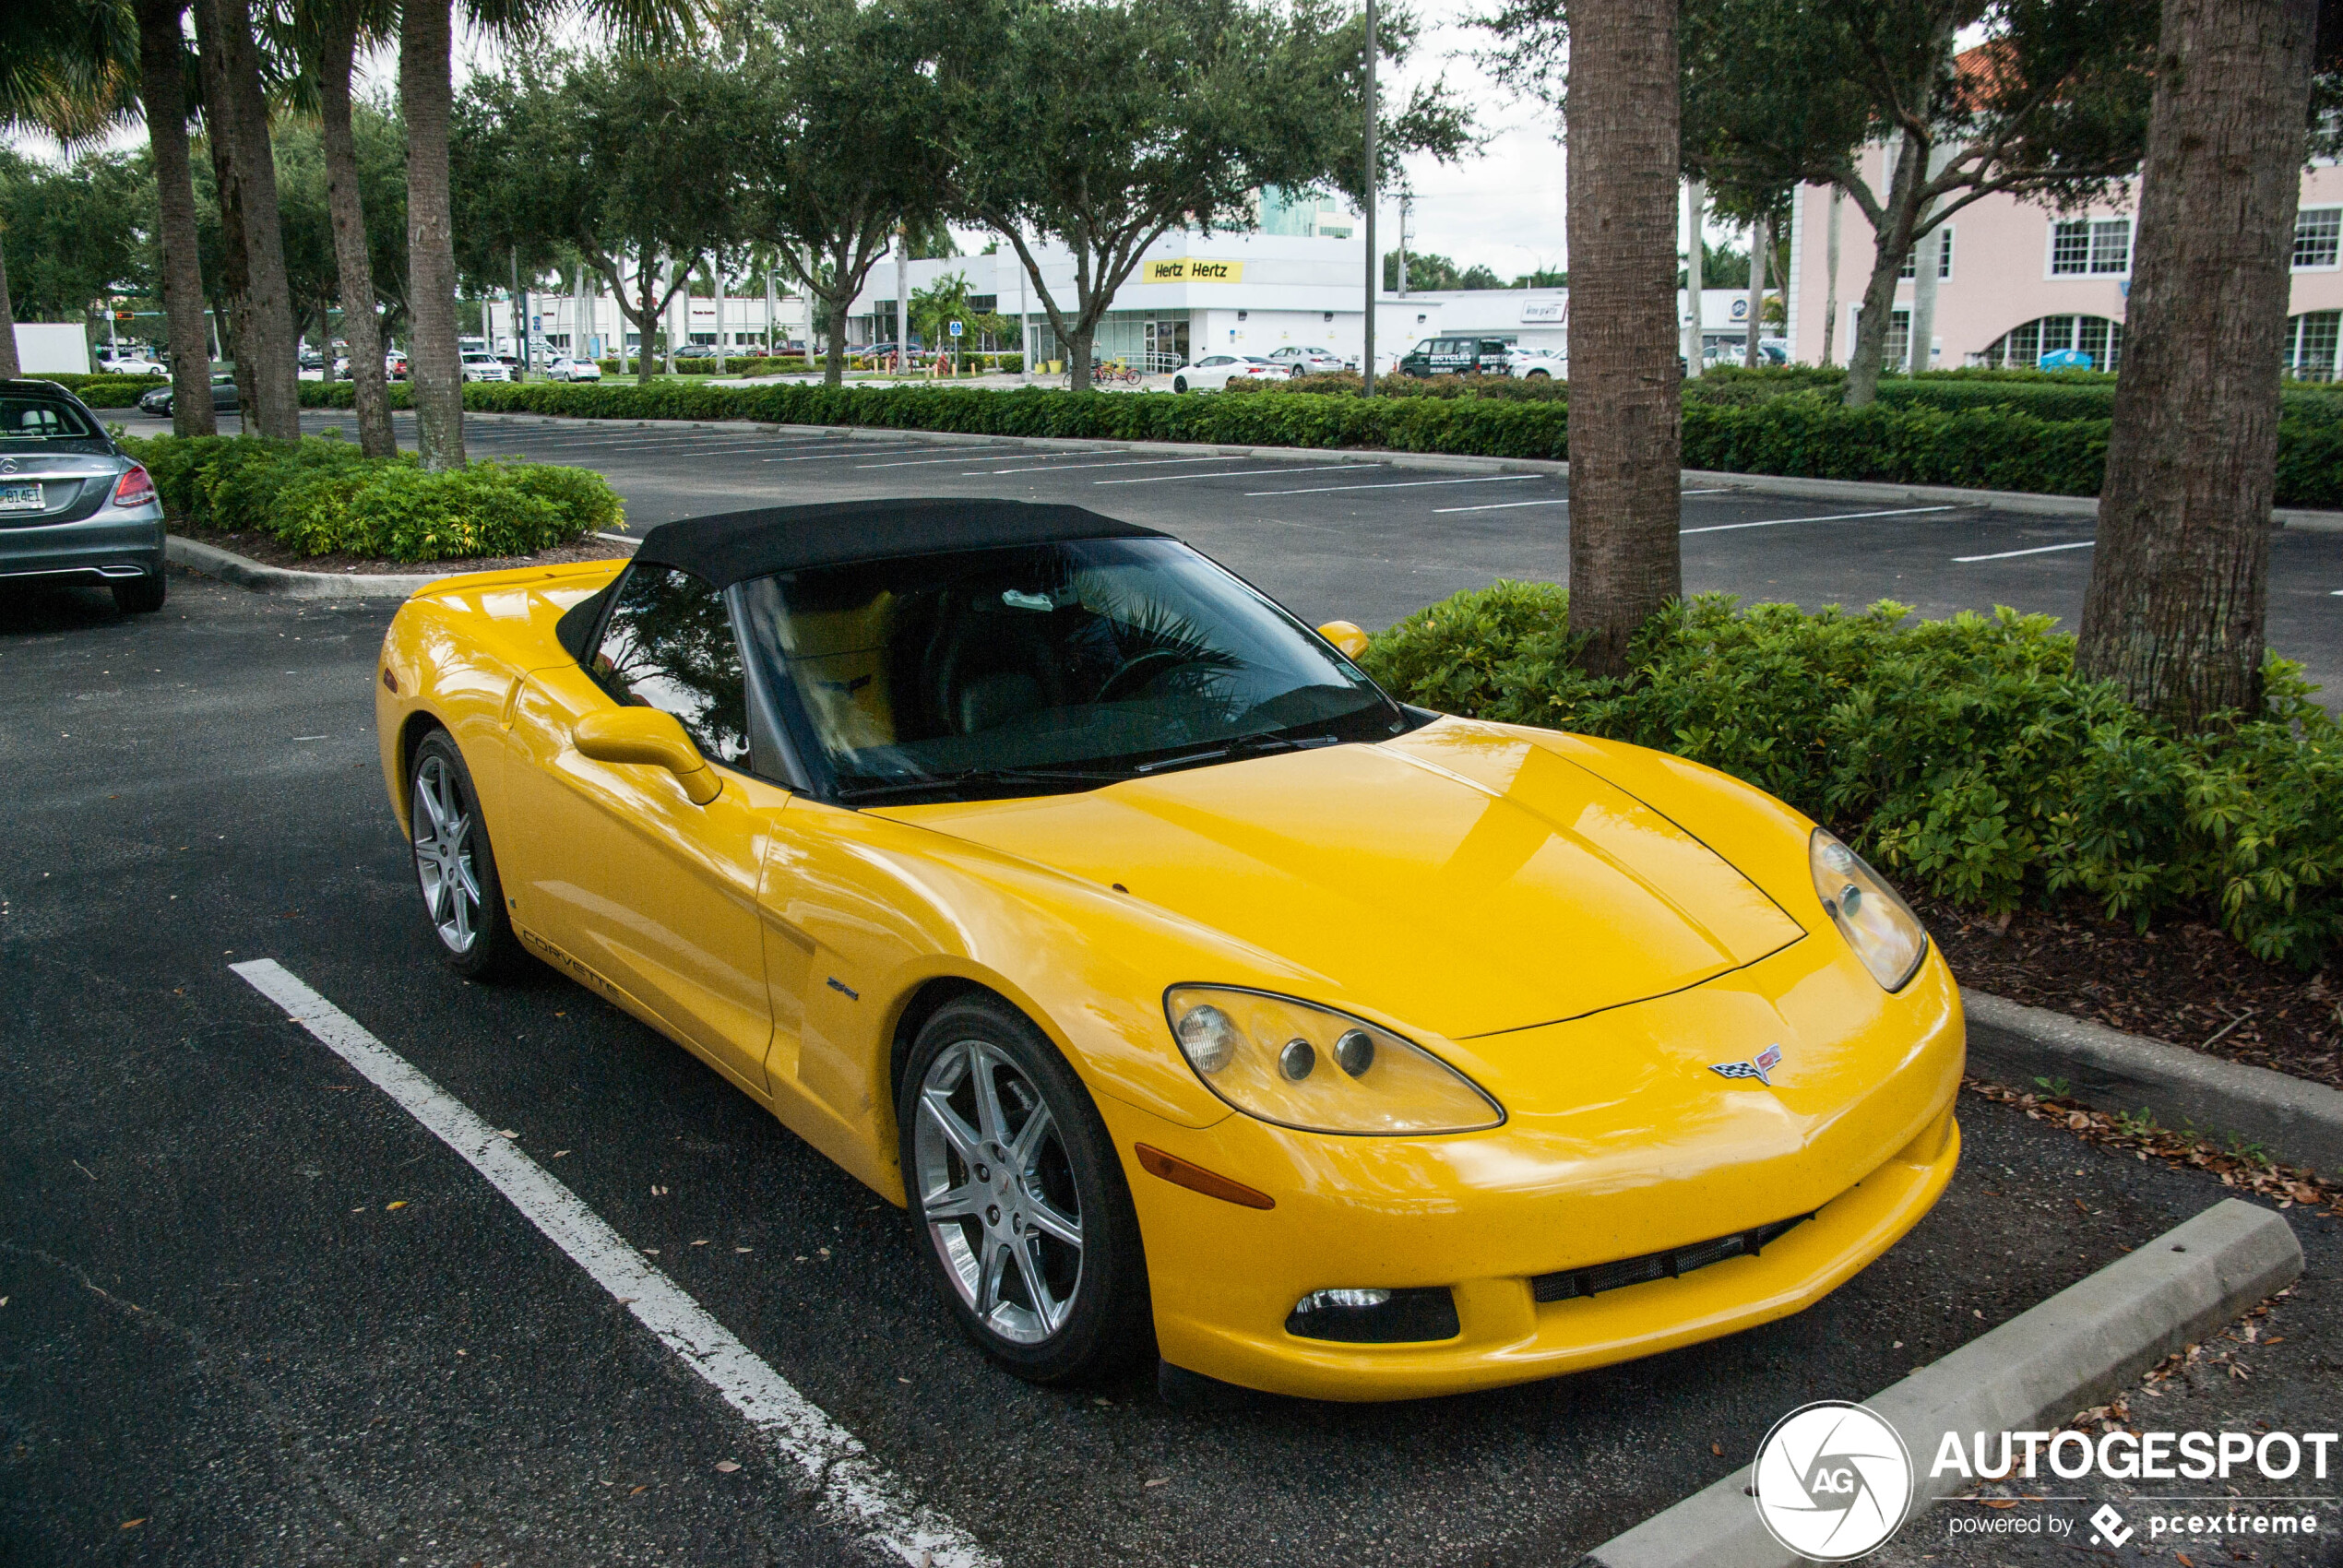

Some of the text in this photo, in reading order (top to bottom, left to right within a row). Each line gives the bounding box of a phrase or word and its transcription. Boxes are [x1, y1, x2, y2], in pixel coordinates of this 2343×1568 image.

[1155, 264, 1183, 278] Hertz
[1192, 263, 1228, 278] Hertz
[523, 929, 620, 1001] CORVETTE
